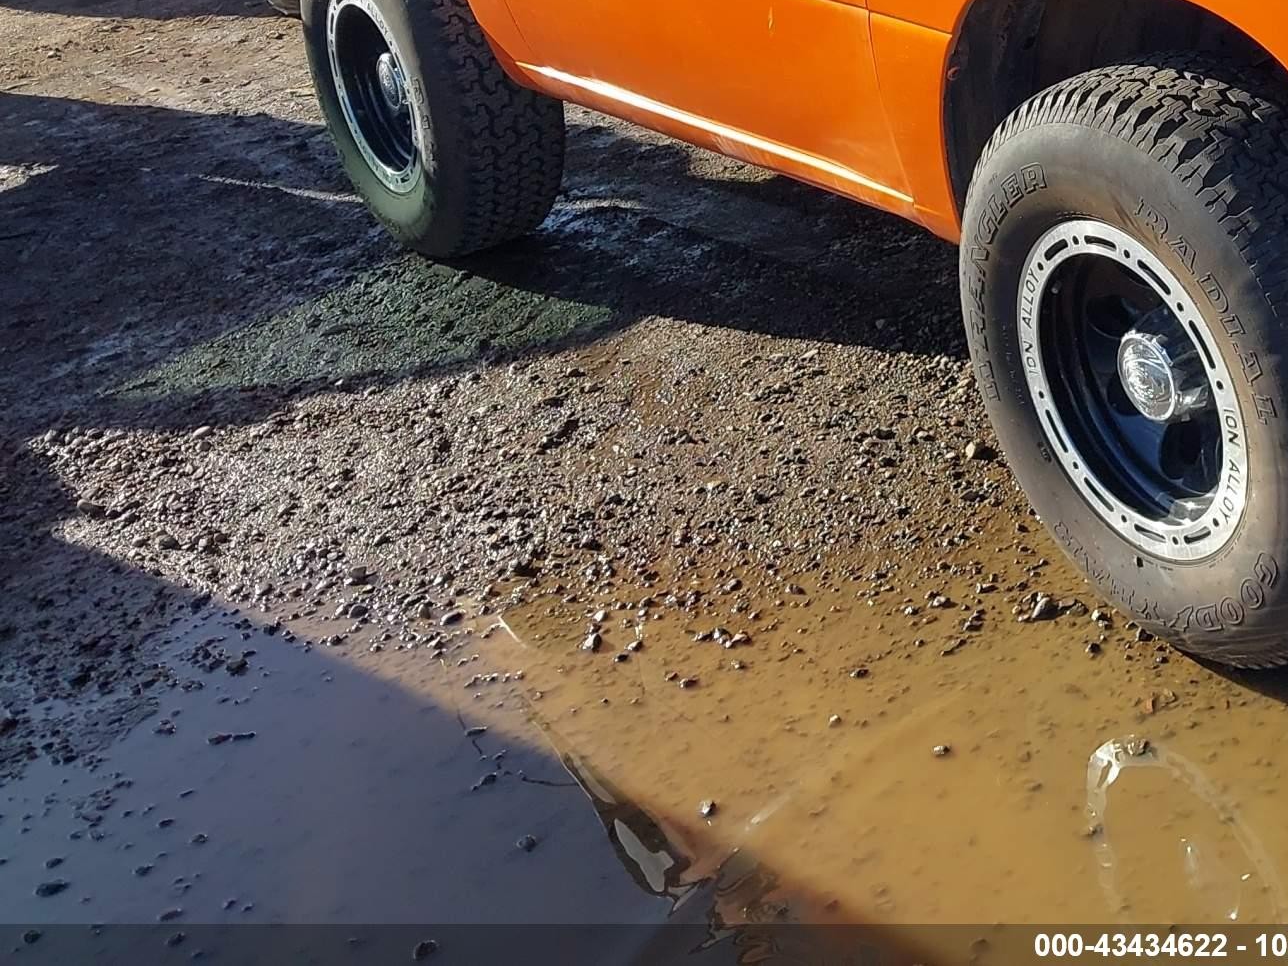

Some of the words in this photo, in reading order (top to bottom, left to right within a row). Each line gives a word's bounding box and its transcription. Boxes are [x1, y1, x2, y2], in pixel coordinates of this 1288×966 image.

[1021, 267, 1040, 330] ALLOY
[1133, 198, 1278, 425] RADIAL
[1025, 340, 1039, 375] ION
[1223, 407, 1241, 448] ION
[1222, 460, 1242, 525] ALLOY
